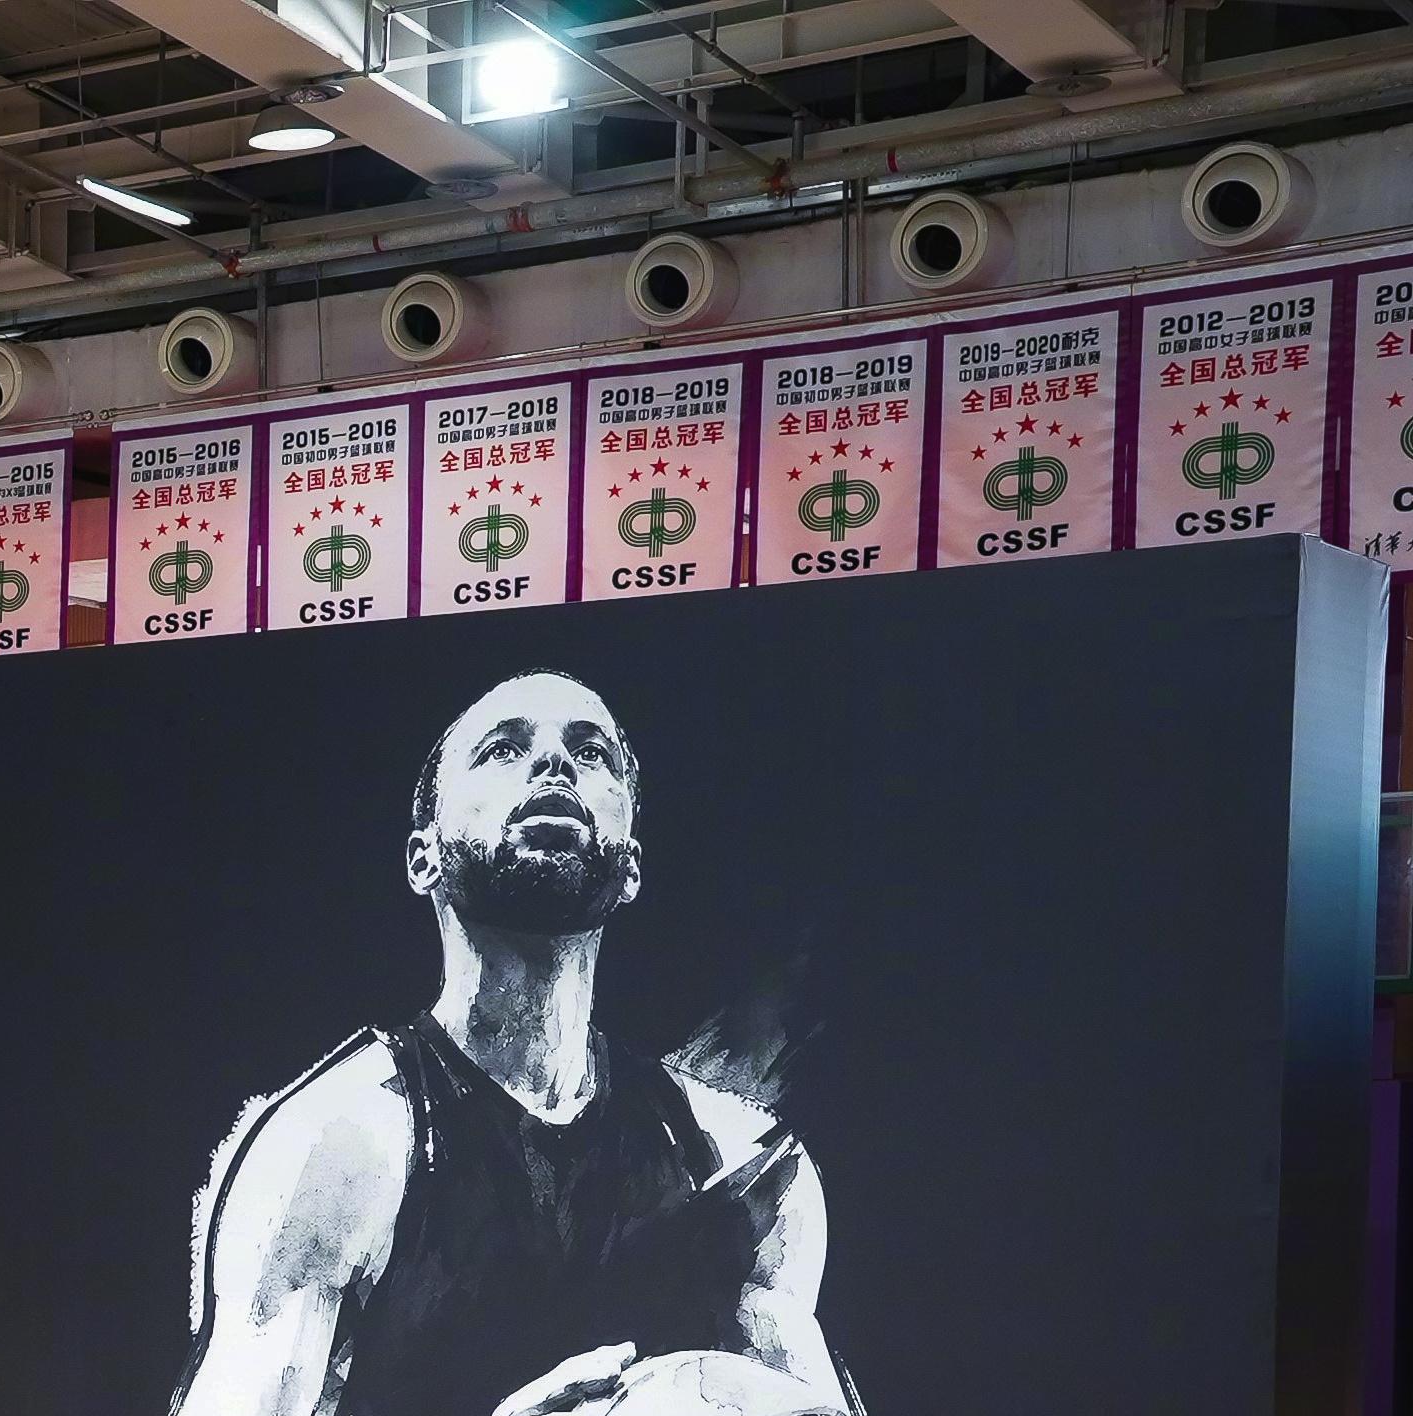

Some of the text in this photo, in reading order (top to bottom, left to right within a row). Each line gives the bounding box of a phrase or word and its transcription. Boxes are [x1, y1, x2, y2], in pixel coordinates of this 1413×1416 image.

[1159, 297, 1315, 338] 2012-2013
[777, 354, 913, 389] 2018-2019
[1159, 344, 1310, 387] 全国总冠军
[600, 378, 730, 408] 2018-2019
[960, 372, 1099, 414] 全国总冠军
[439, 397, 558, 429] 2017-2018
[778, 399, 909, 437] 全国总冠军
[282, 419, 397, 450] 2015-2016
[600, 421, 725, 454] 全国总冠军
[439, 438, 556, 473] 全国总冠军
[283, 460, 395, 494] 全国总冠军
[132, 478, 238, 510] 全国总冠军
[1175, 503, 1276, 537] CSSF
[976, 523, 1069, 557] CSSF
[611, 563, 697, 590] CSSF
[791, 546, 881, 575] CSSF
[453, 576, 530, 605] CSSF
[144, 609, 214, 635] CSSF
[299, 596, 374, 624] CSSF
